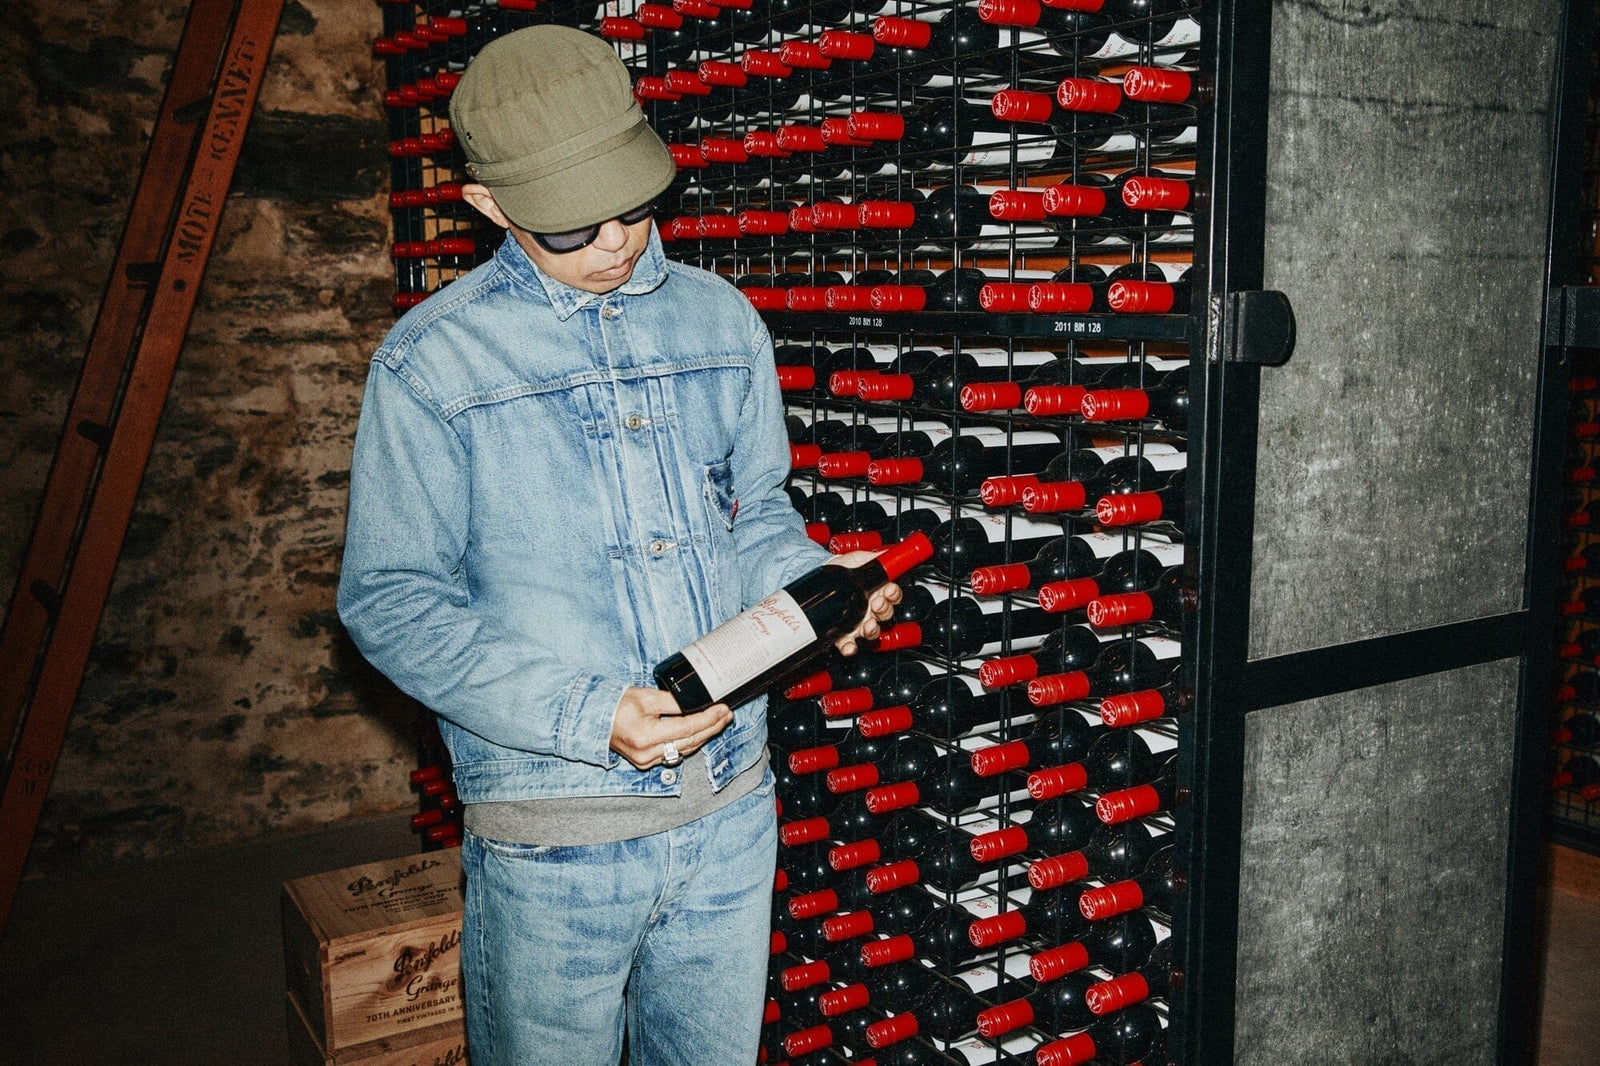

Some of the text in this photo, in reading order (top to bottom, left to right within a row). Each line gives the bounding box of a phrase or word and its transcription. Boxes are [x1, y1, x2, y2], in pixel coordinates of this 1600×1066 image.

[849, 316, 861, 326] 2010
[873, 318, 883, 327] 128
[1054, 321, 1101, 333] 2011 BIN 128
[406, 975, 457, 1001] Grange
[366, 995, 456, 1023] 70TH ANNIVERSARY
[397, 1016, 415, 1025] FIRST
